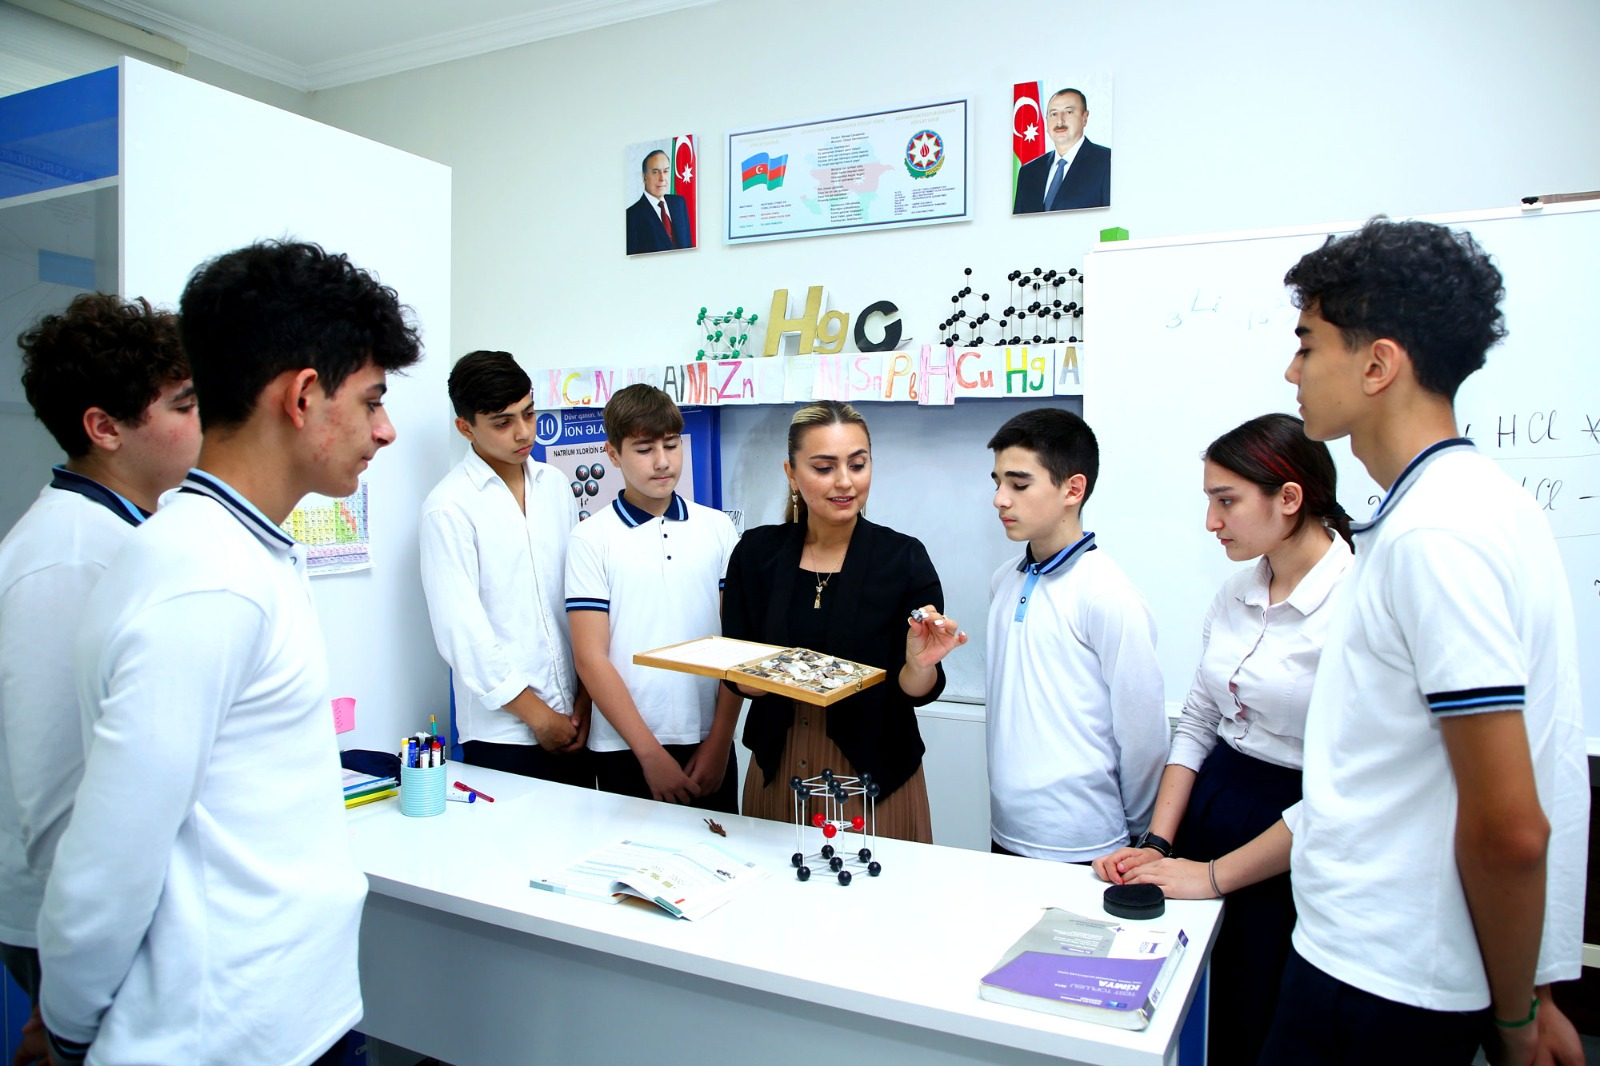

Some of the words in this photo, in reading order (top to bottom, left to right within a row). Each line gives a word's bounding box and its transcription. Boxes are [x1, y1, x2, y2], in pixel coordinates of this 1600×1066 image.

[763, 286, 849, 356] Hg
[562, 372, 592, 405] Ca
[663, 366, 686, 403] Al
[687, 362, 719, 404] Mn
[718, 361, 754, 399] Zn
[851, 356, 881, 391] Sn
[918, 344, 956, 405] H
[956, 351, 994, 389] Cu
[1006, 347, 1046, 394] Hg
[539, 418, 554, 436] 10
[564, 425, 583, 438] İON
[553, 448, 576, 458] NATRİUM
[576, 446, 599, 456] XLORİDİN
[1098, 979, 1141, 992] KİMYA
